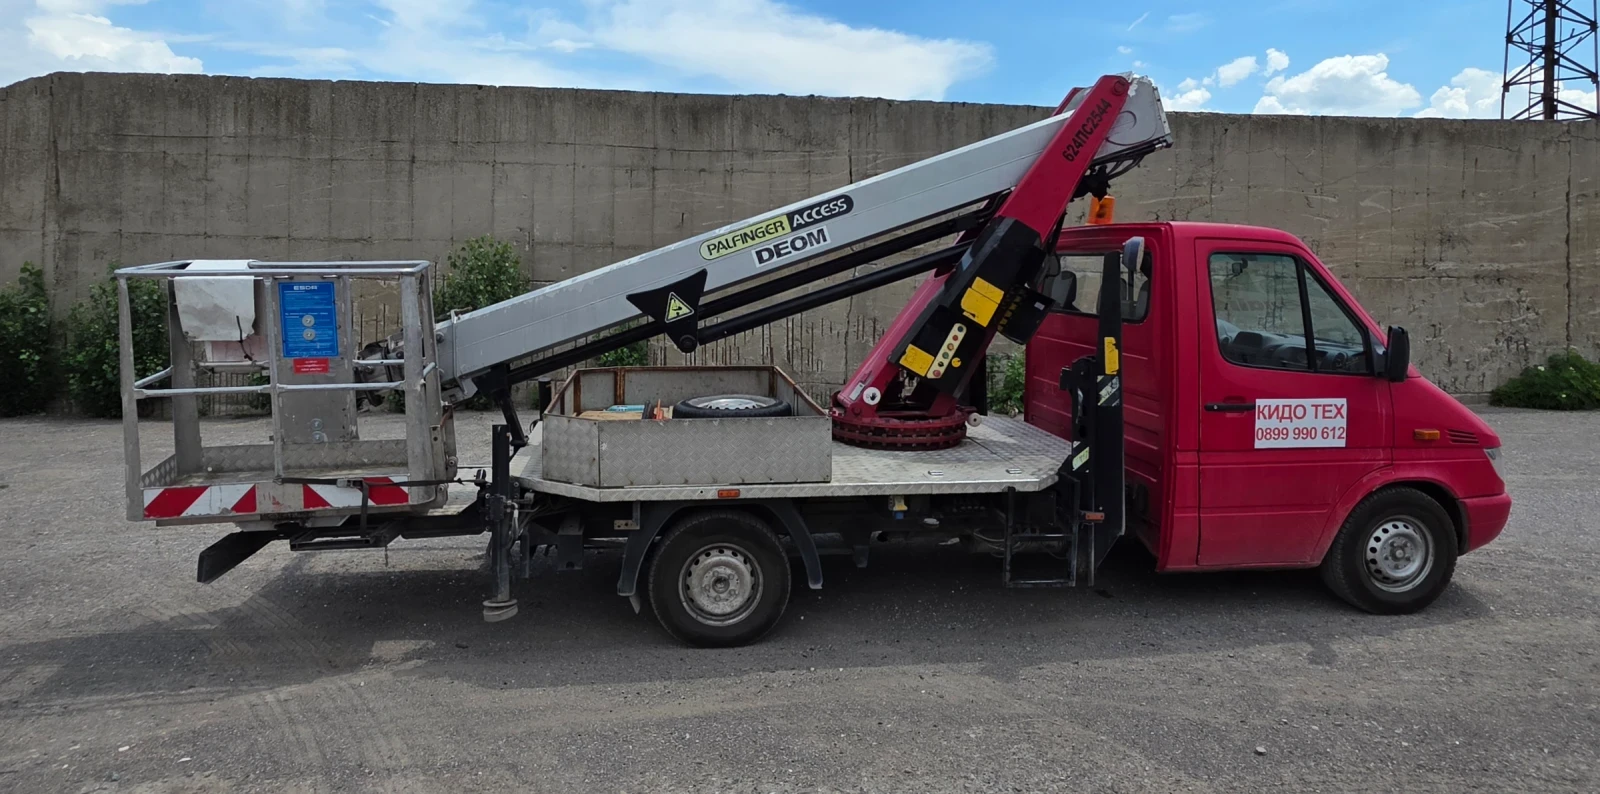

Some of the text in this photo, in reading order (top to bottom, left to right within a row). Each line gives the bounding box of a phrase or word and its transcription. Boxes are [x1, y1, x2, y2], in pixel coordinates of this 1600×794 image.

[706, 198, 848, 256] PALFINGER ACCESS
[755, 228, 828, 265] DEOM
[1257, 403, 1345, 423] КИДО ТЕХ
[1256, 426, 1346, 441] 0899 990 612
